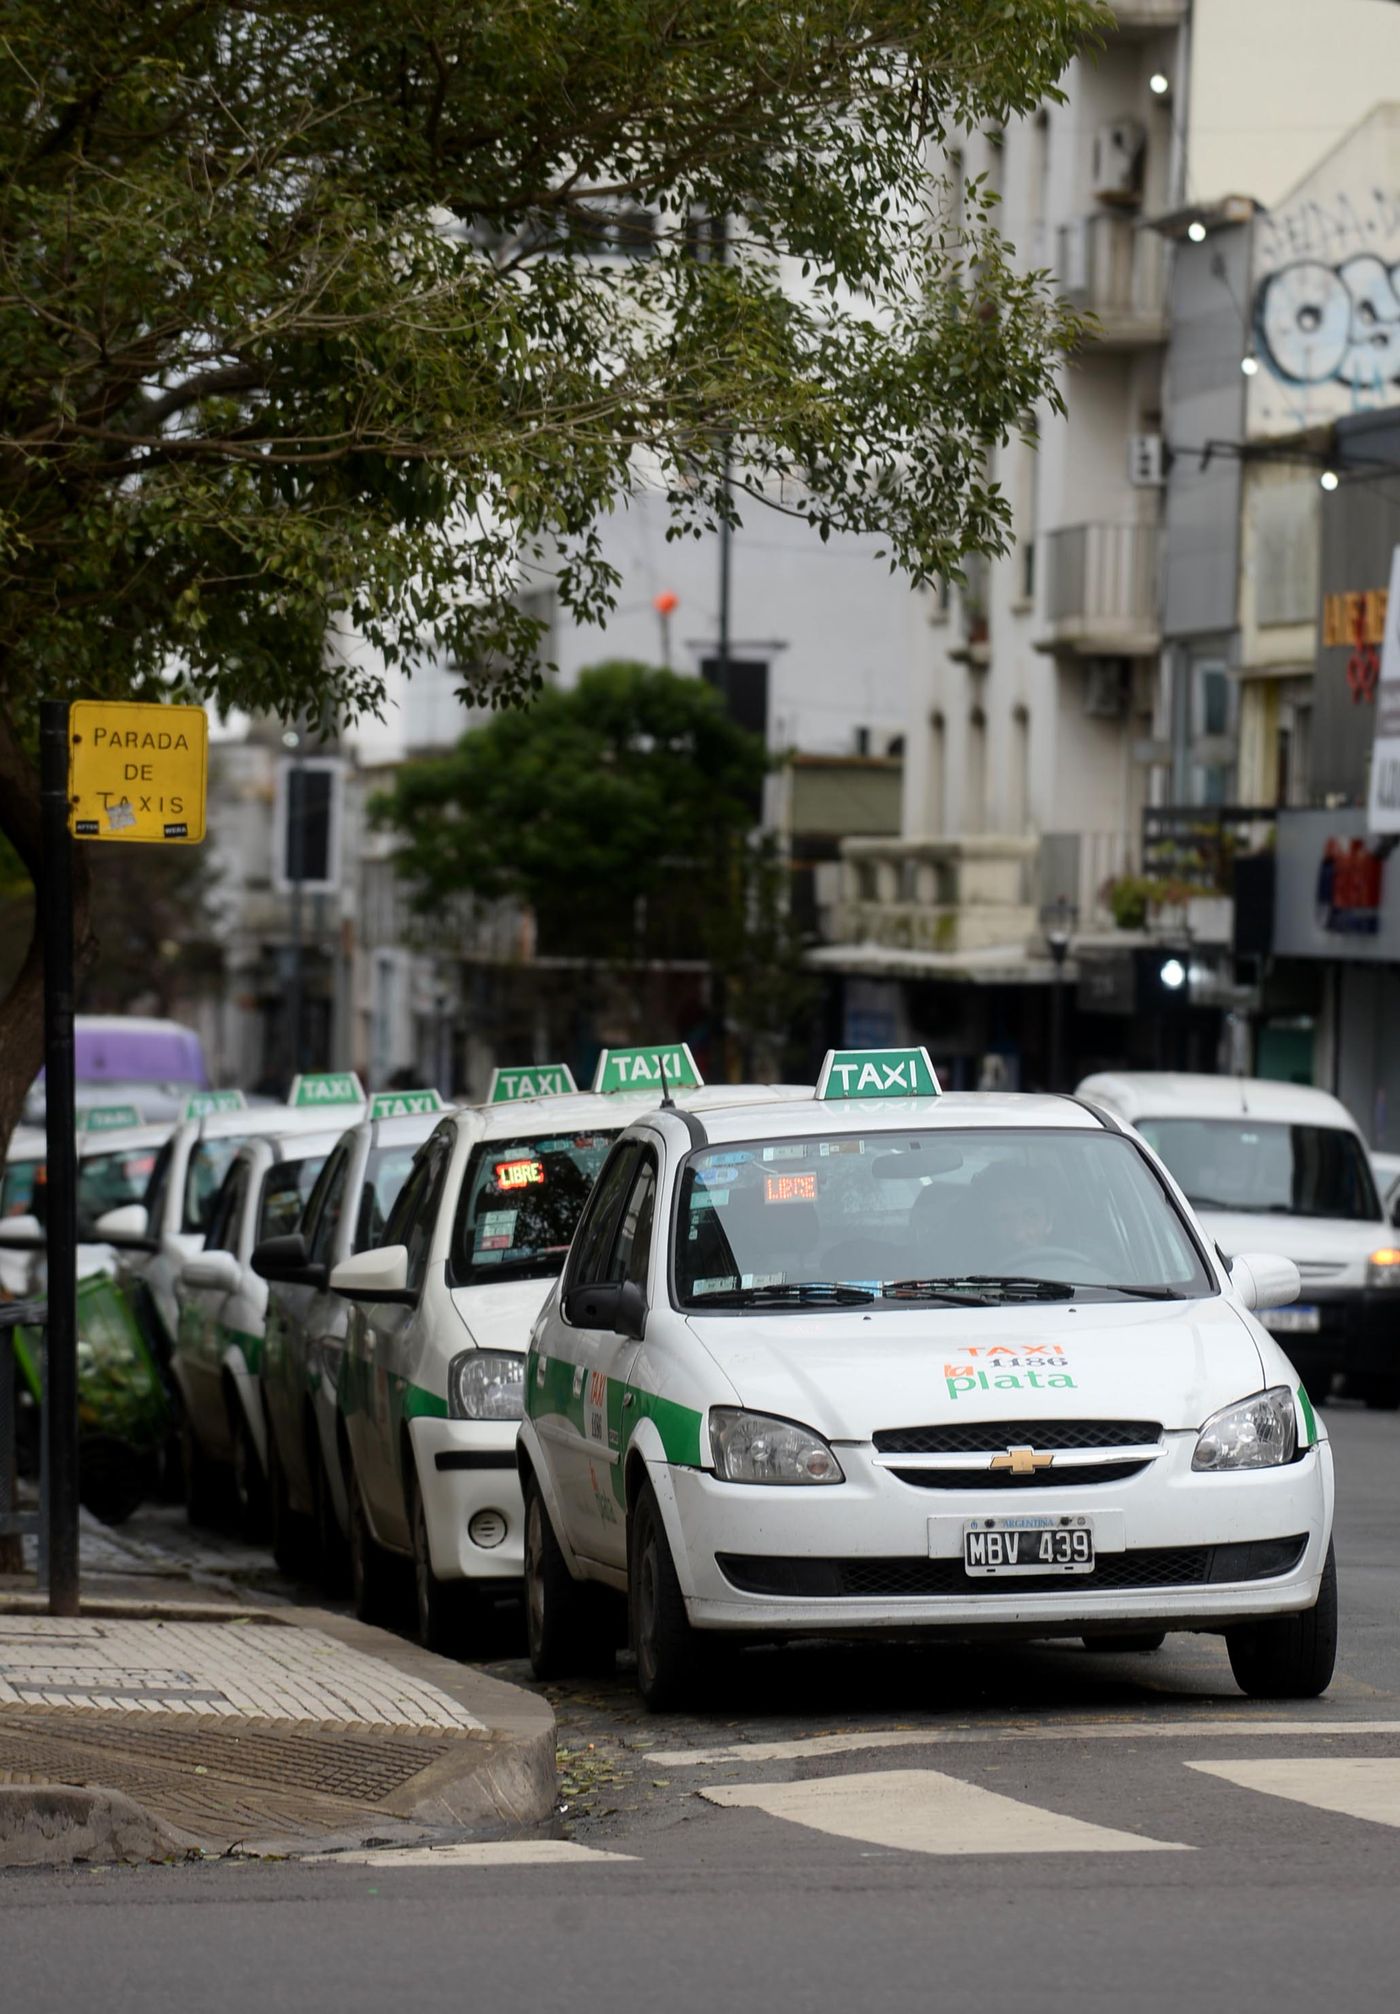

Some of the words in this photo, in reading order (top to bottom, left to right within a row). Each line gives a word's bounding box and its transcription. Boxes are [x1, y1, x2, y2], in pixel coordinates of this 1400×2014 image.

[94, 727, 188, 751] PARADA
[124, 764, 153, 781] DE
[96, 791, 183, 814] TAXIS
[608, 1053, 681, 1082] TAXI
[832, 1060, 917, 1090] TAXI
[302, 1078, 353, 1098] TAXI
[501, 1073, 562, 1098] TAXI
[377, 1097, 433, 1117] TAXI
[501, 1163, 540, 1185] LIBRE
[957, 1344, 1064, 1357] TAXI
[944, 1364, 974, 1378] la
[989, 1357, 1069, 1368] 1186
[946, 1370, 1079, 1400] plata
[1003, 1519, 1056, 1529] ARGENTINA
[970, 1532, 1020, 1565] MBV
[1039, 1530, 1089, 1563] 439
